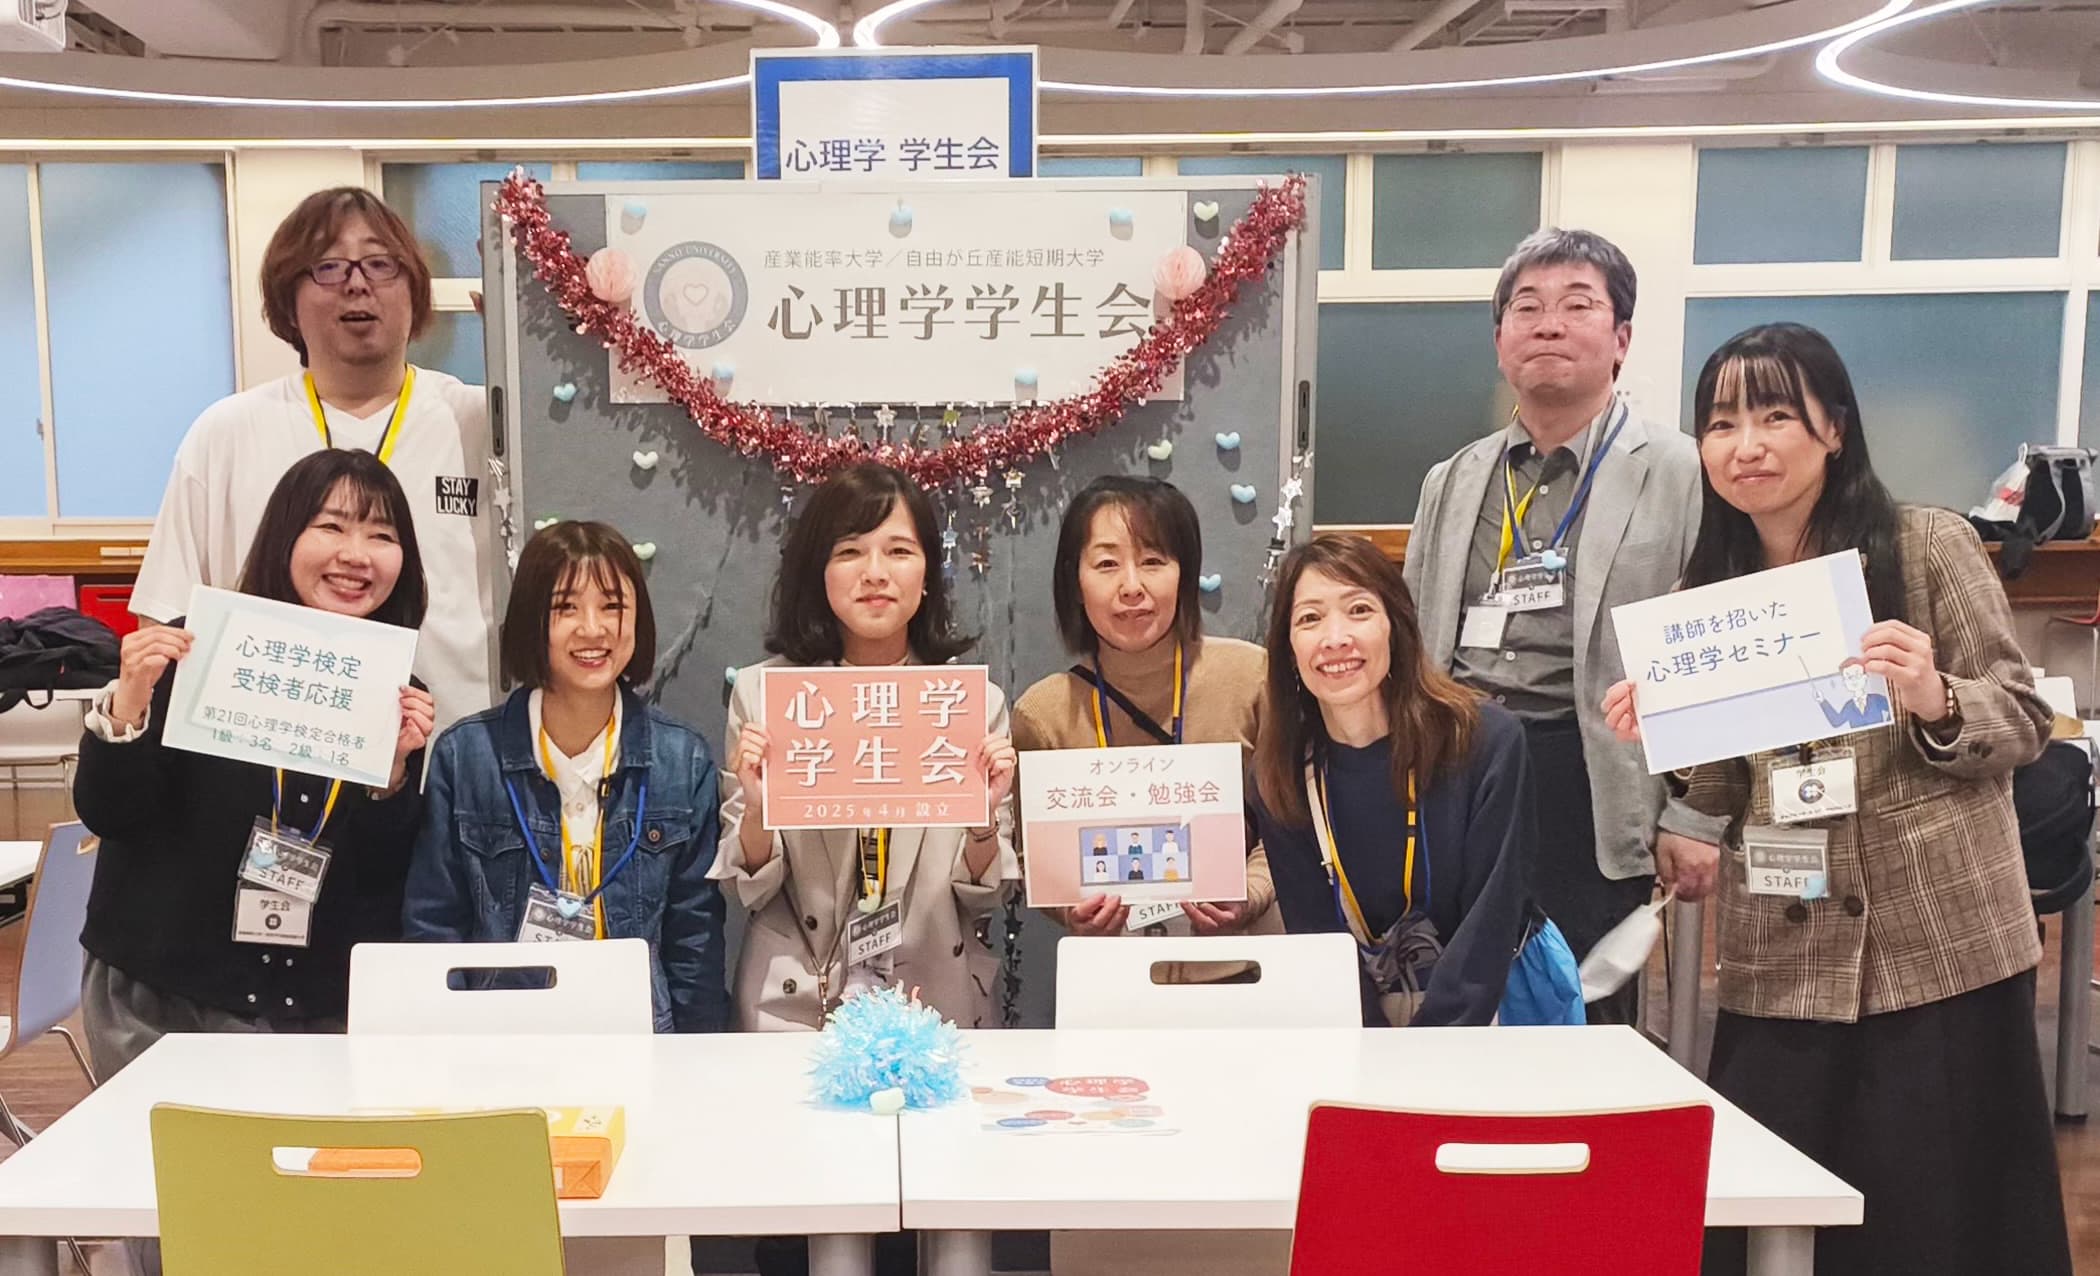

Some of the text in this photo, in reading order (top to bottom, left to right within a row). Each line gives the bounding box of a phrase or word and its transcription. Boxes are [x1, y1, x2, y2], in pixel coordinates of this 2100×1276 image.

[785, 136, 1000, 172] 心理学 学生会
[767, 281, 1151, 341] 心理学学生会
[437, 495, 476, 515] LUCKY
[441, 477, 471, 496] STAY
[1513, 590, 1551, 606] STAFF
[1663, 600, 1788, 645] 講師を招いた
[235, 634, 362, 680] 心理学検定
[1646, 631, 1821, 683] 心理学セミナー
[231, 667, 354, 711] 受検者応援
[784, 678, 969, 729] 心理学
[785, 735, 970, 787] 学生会
[1089, 757, 1174, 775] オンライン
[258, 867, 305, 890] STAFF
[858, 931, 891, 955] STAFF
